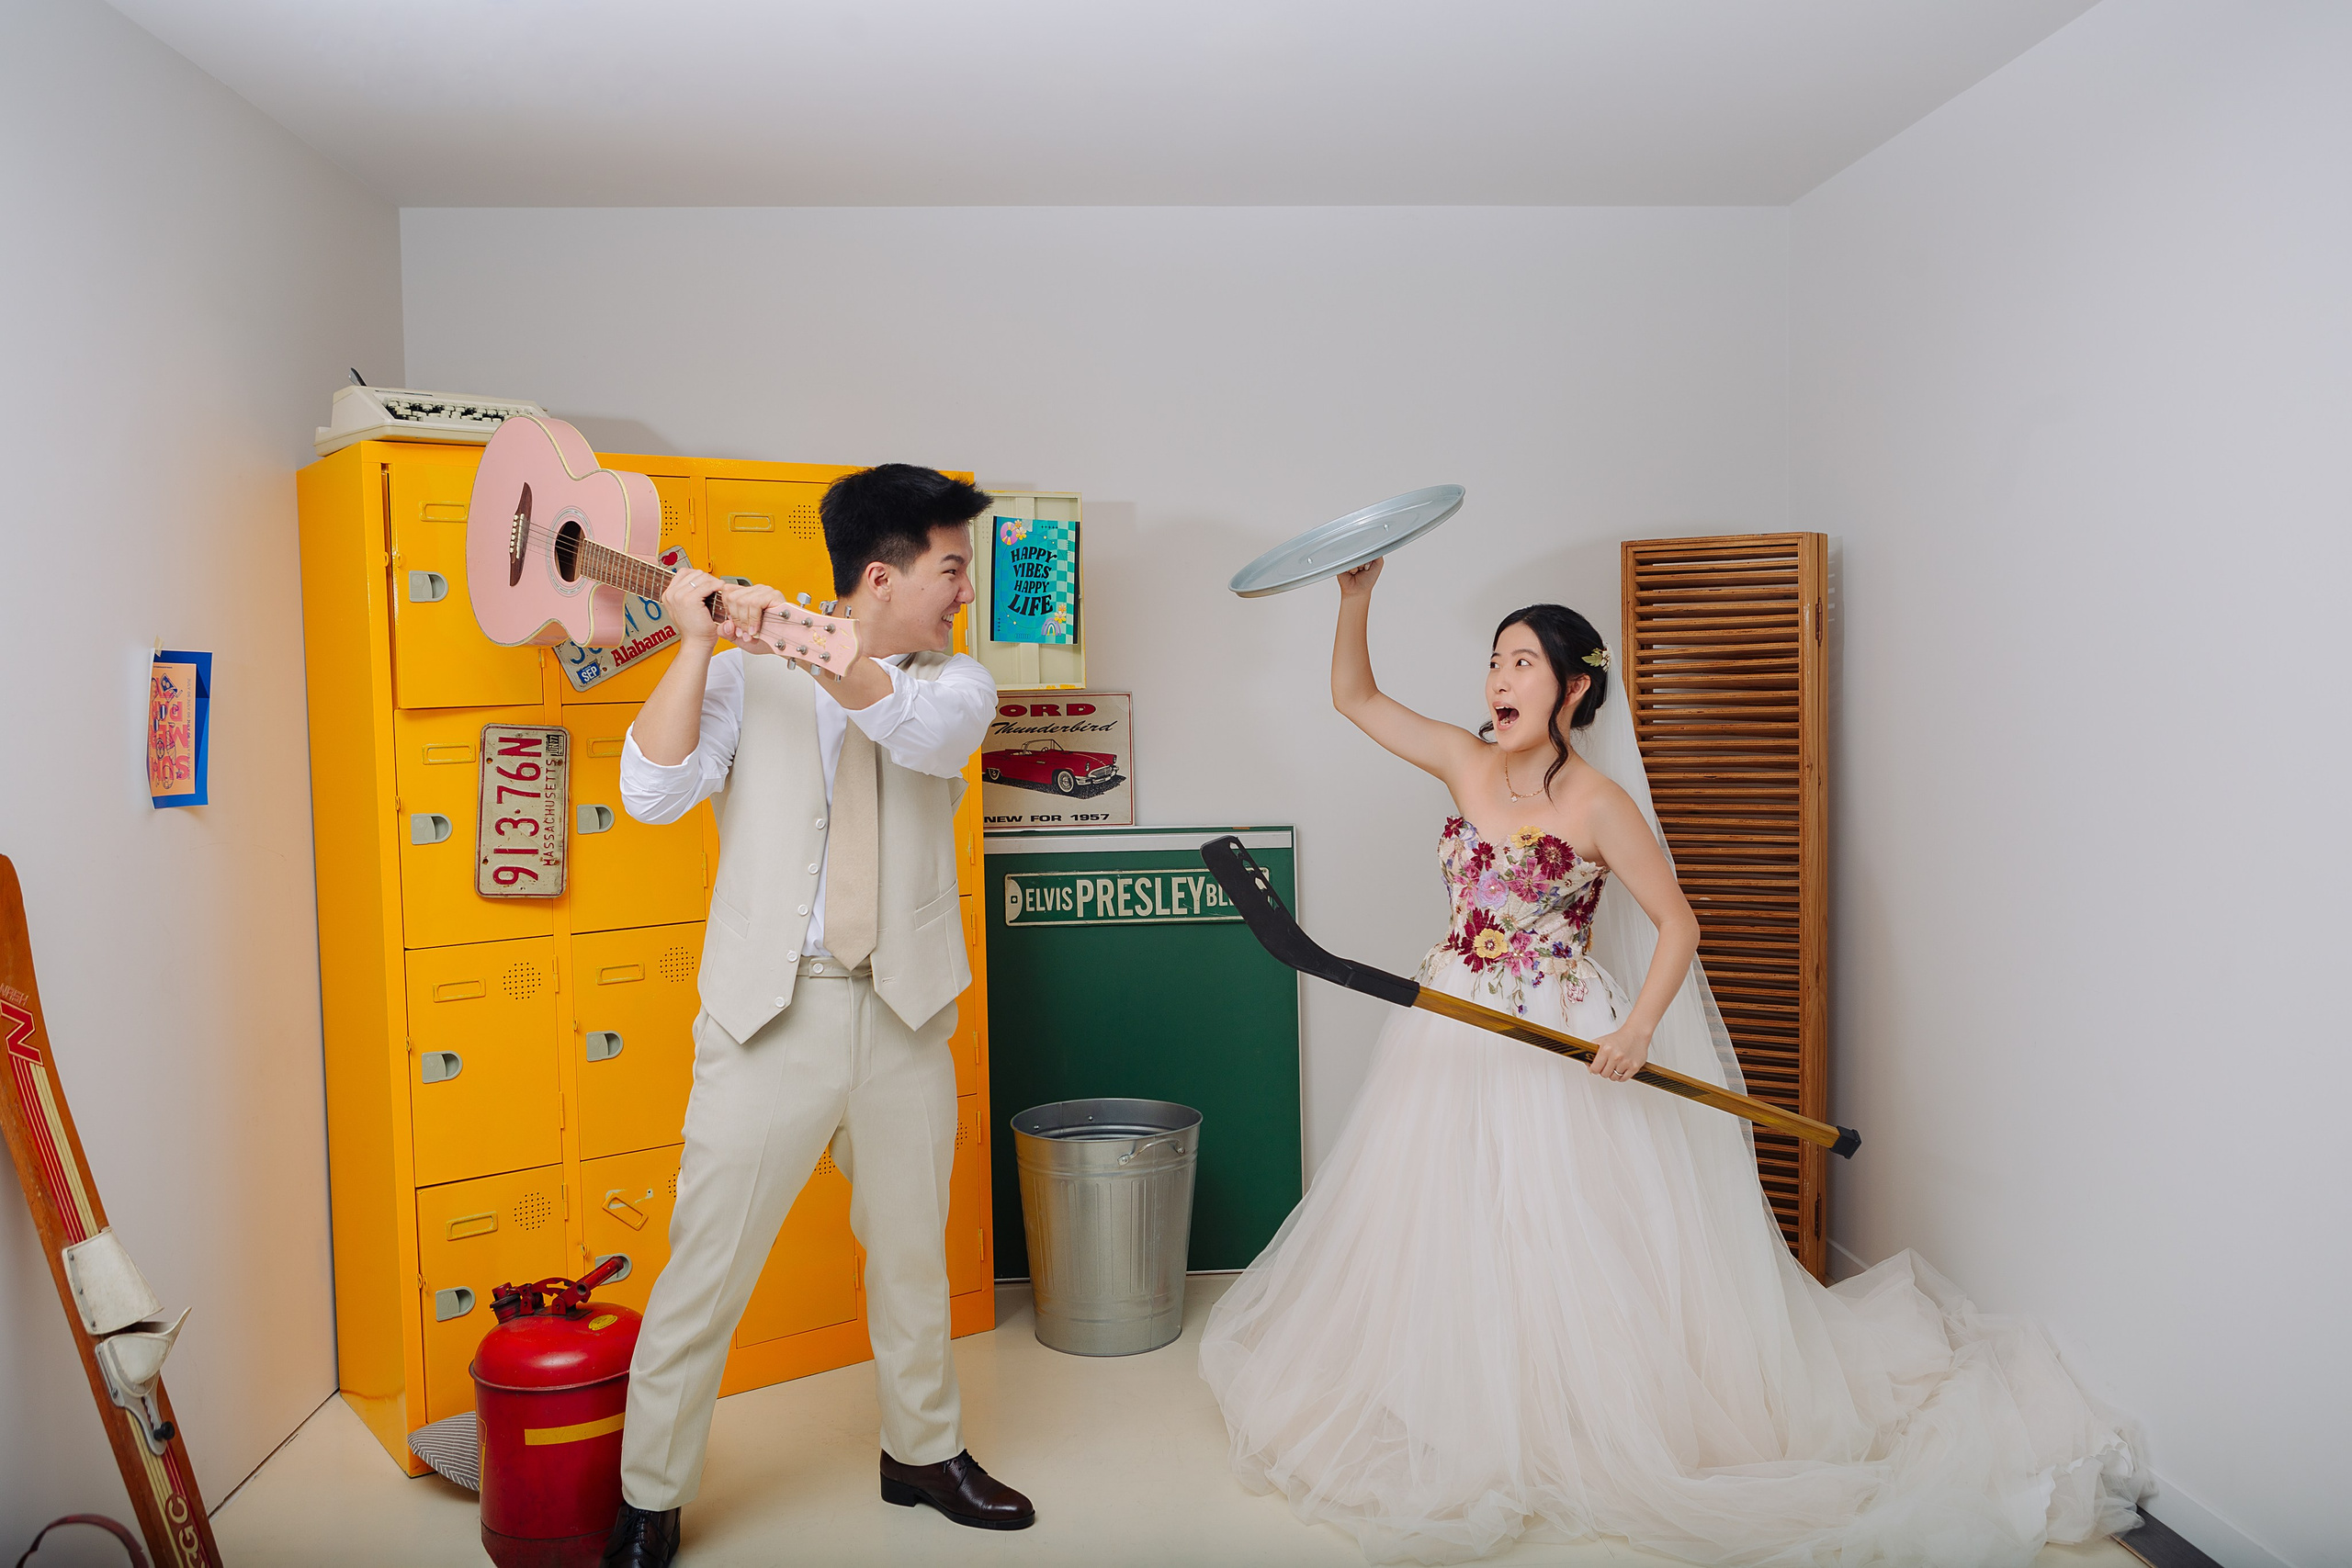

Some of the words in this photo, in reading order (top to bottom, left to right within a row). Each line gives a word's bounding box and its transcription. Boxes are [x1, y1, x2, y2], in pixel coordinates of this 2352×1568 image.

[1011, 547, 1057, 563] HAPPY
[1012, 562, 1052, 579] VIBES
[1013, 580, 1049, 593] HAPPY
[1007, 593, 1054, 616] LIFE
[611, 625, 676, 668] Alabama
[581, 663, 598, 683] SEP
[995, 703, 1096, 717] ORD
[991, 720, 1118, 735] Thunderbird
[542, 759, 557, 866] MASSACHUSETTS
[983, 815, 1023, 823] NEW
[1025, 887, 1073, 912] ELVIS
[1076, 876, 1205, 918] PRESLEY
